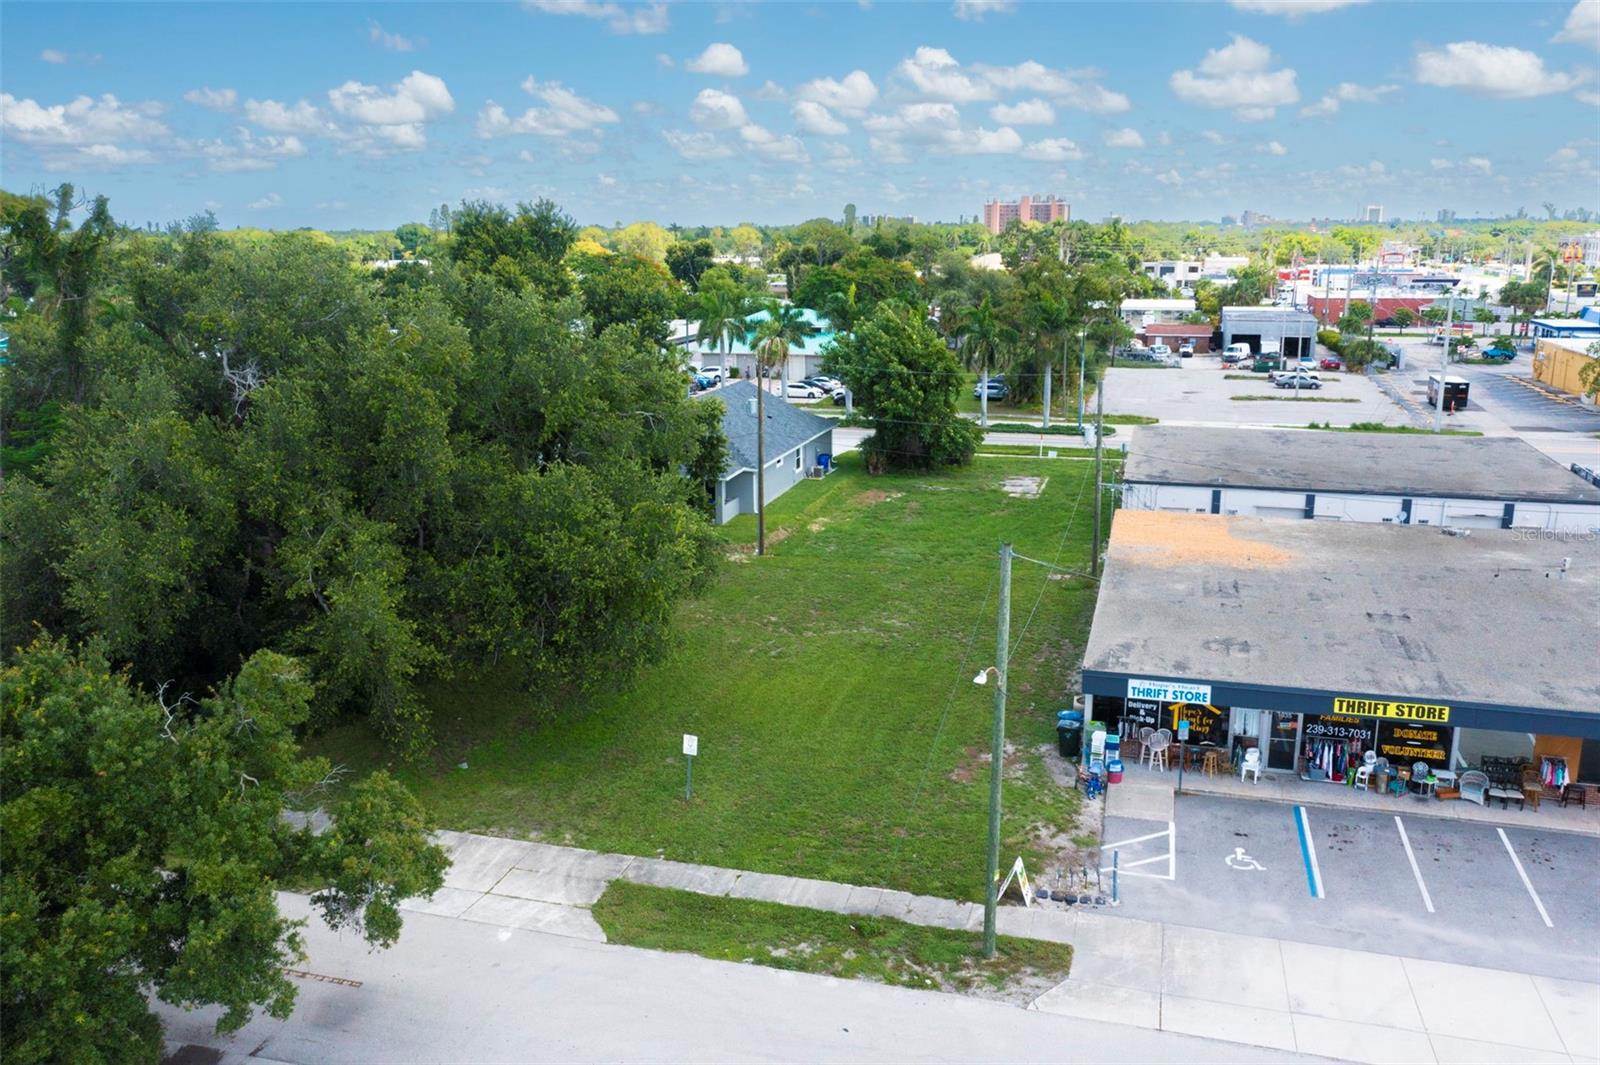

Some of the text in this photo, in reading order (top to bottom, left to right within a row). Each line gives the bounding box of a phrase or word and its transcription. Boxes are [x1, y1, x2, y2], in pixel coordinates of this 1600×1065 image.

[1131, 686, 1208, 703] THRIFT STORE
[1128, 701, 1157, 711] Delivery
[1139, 708, 1146, 716] &
[1337, 699, 1447, 720] THRIFT STORE
[1306, 723, 1372, 740] 239-313-7031
[1381, 744, 1446, 760] VOLUNTEER
